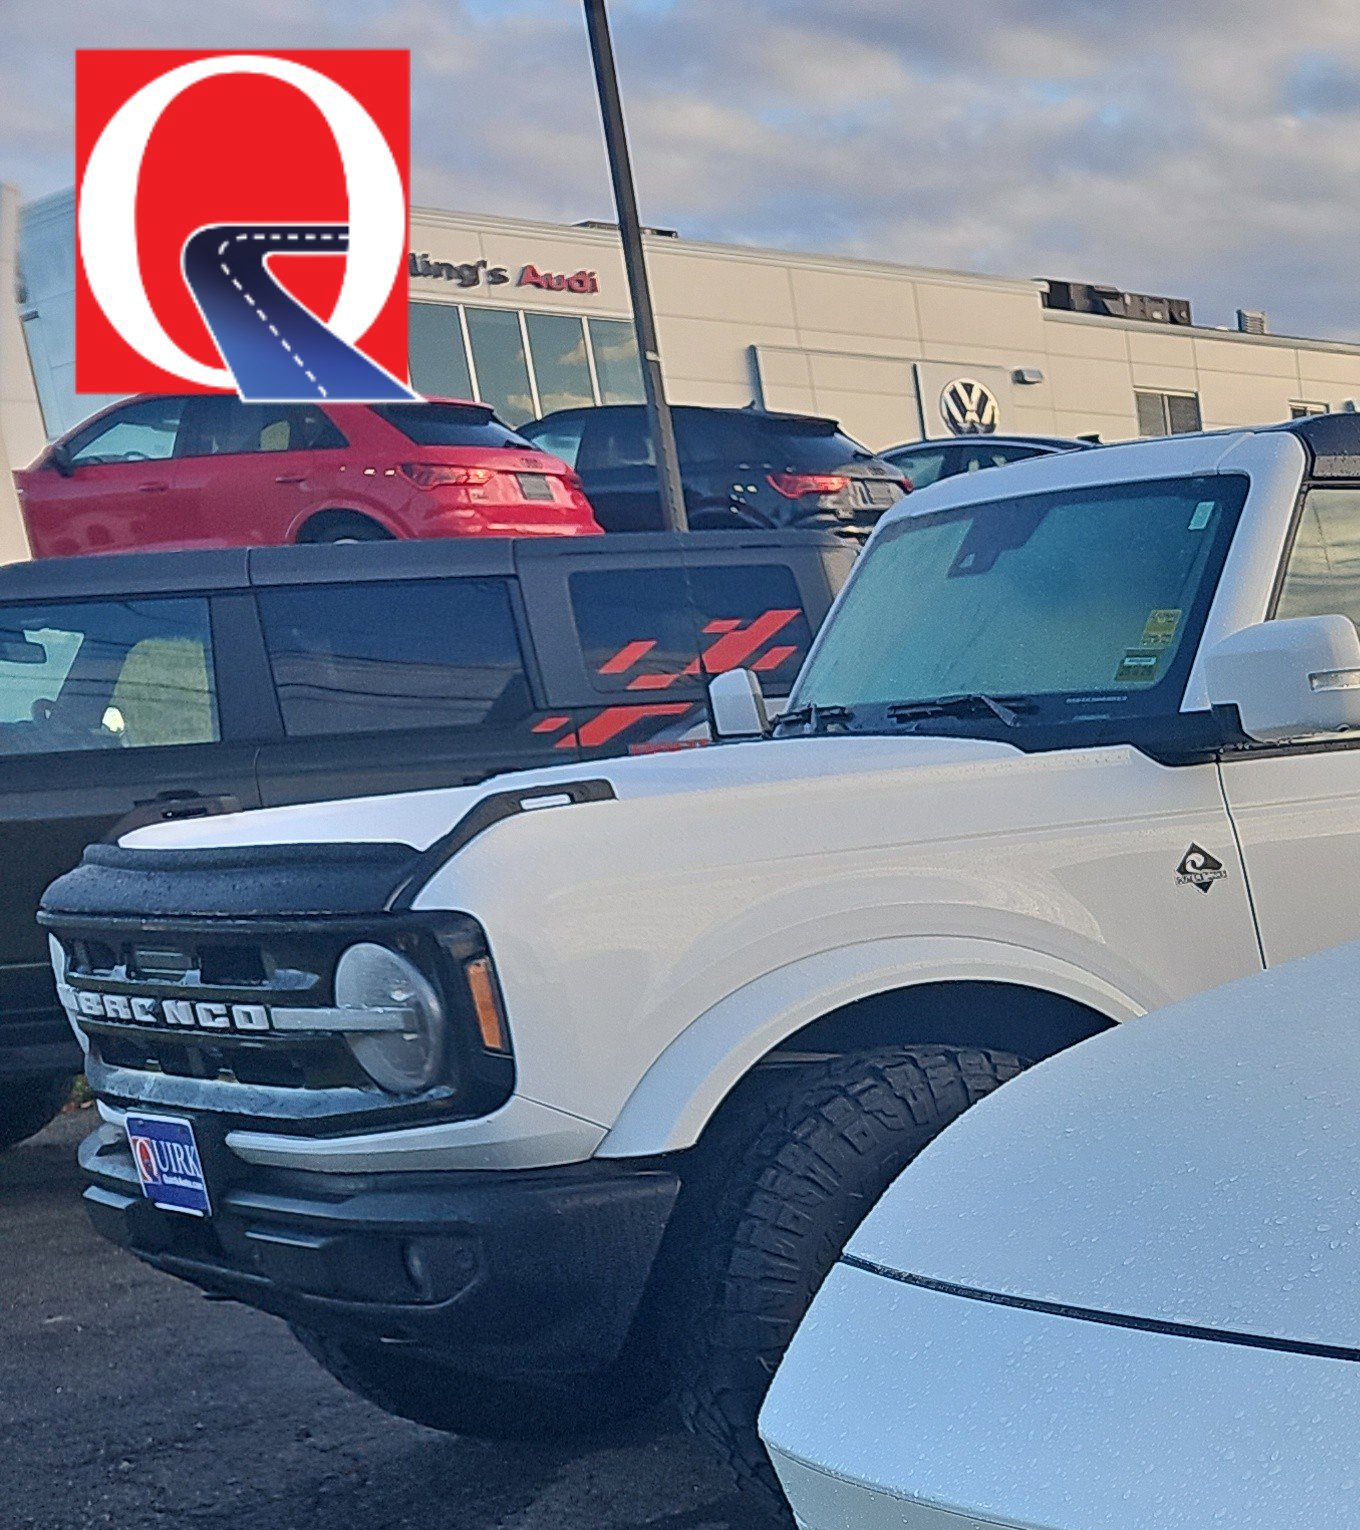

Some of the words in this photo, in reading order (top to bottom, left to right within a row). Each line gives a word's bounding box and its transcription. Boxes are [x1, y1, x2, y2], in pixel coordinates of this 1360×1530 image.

[409, 252, 511, 288] ling's
[515, 264, 600, 294] Audi
[77, 990, 270, 1031] BRONCO
[135, 1137, 204, 1183] QUIRK
